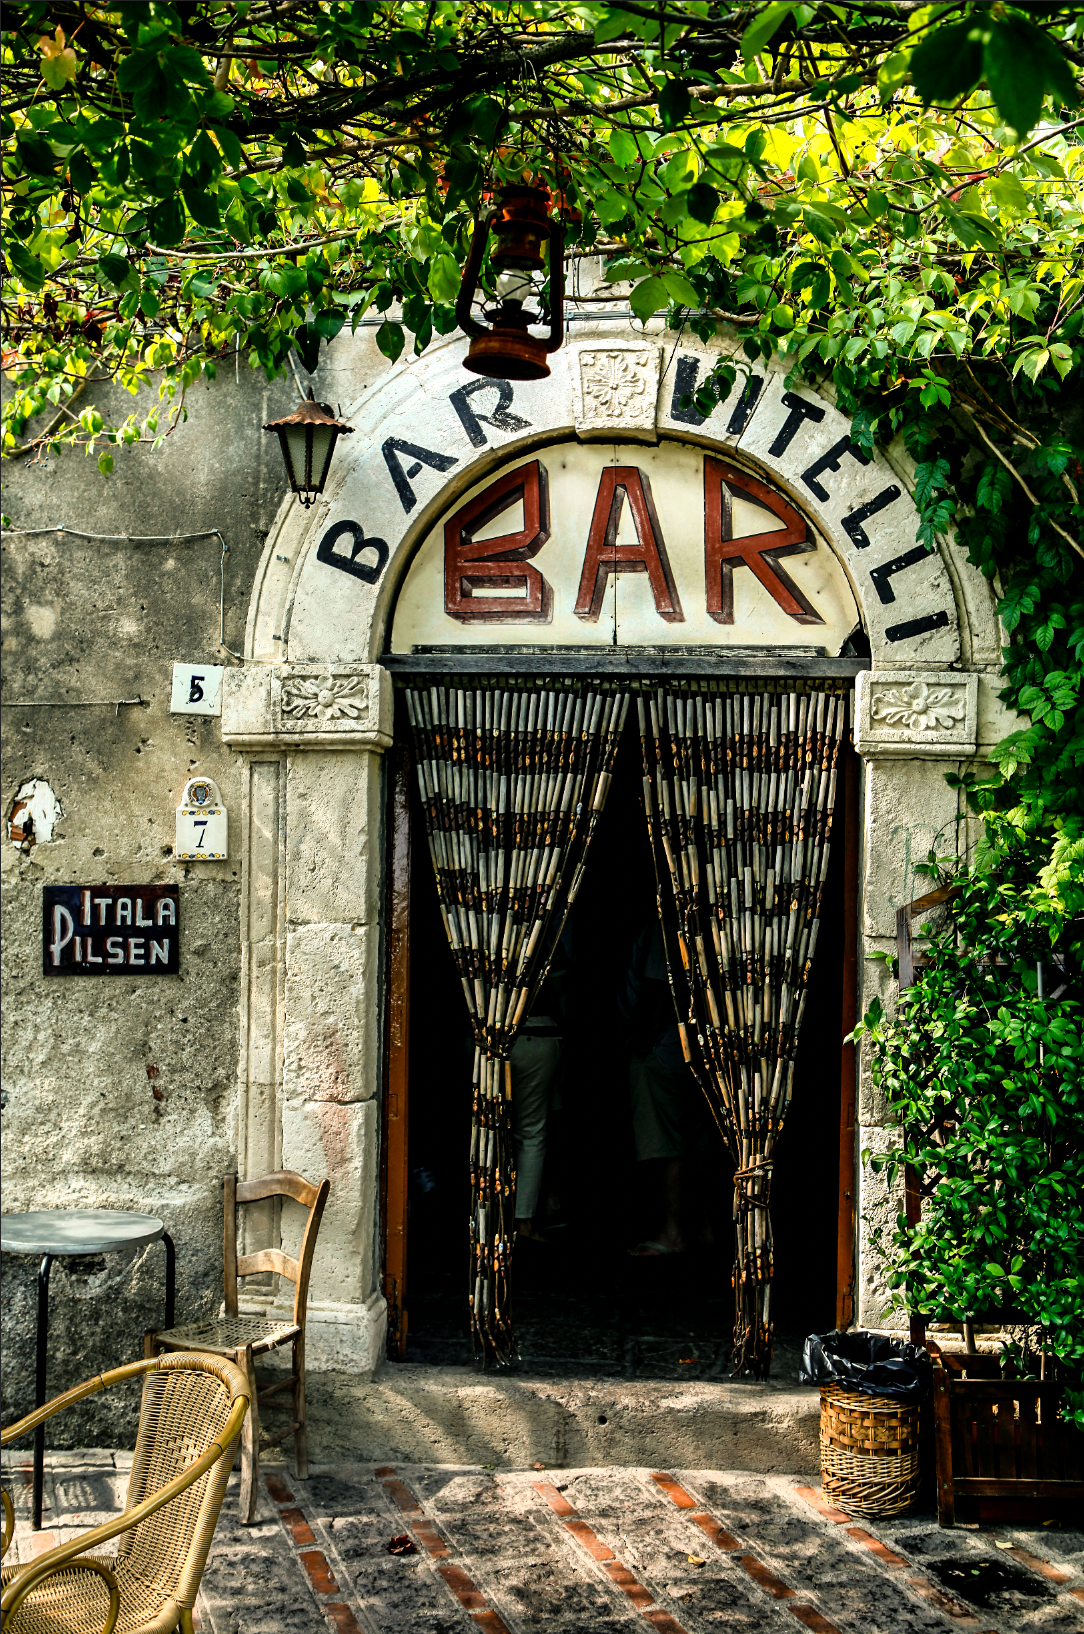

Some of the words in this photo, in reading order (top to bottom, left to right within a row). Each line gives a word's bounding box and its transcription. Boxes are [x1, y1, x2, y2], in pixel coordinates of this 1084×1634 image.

[316, 376, 533, 586] BAR
[444, 454, 827, 626] BAR
[189, 674, 205, 703] 5
[193, 820, 208, 849] 7
[80, 889, 176, 927] ITALA
[49, 904, 170, 966] PILSEN
